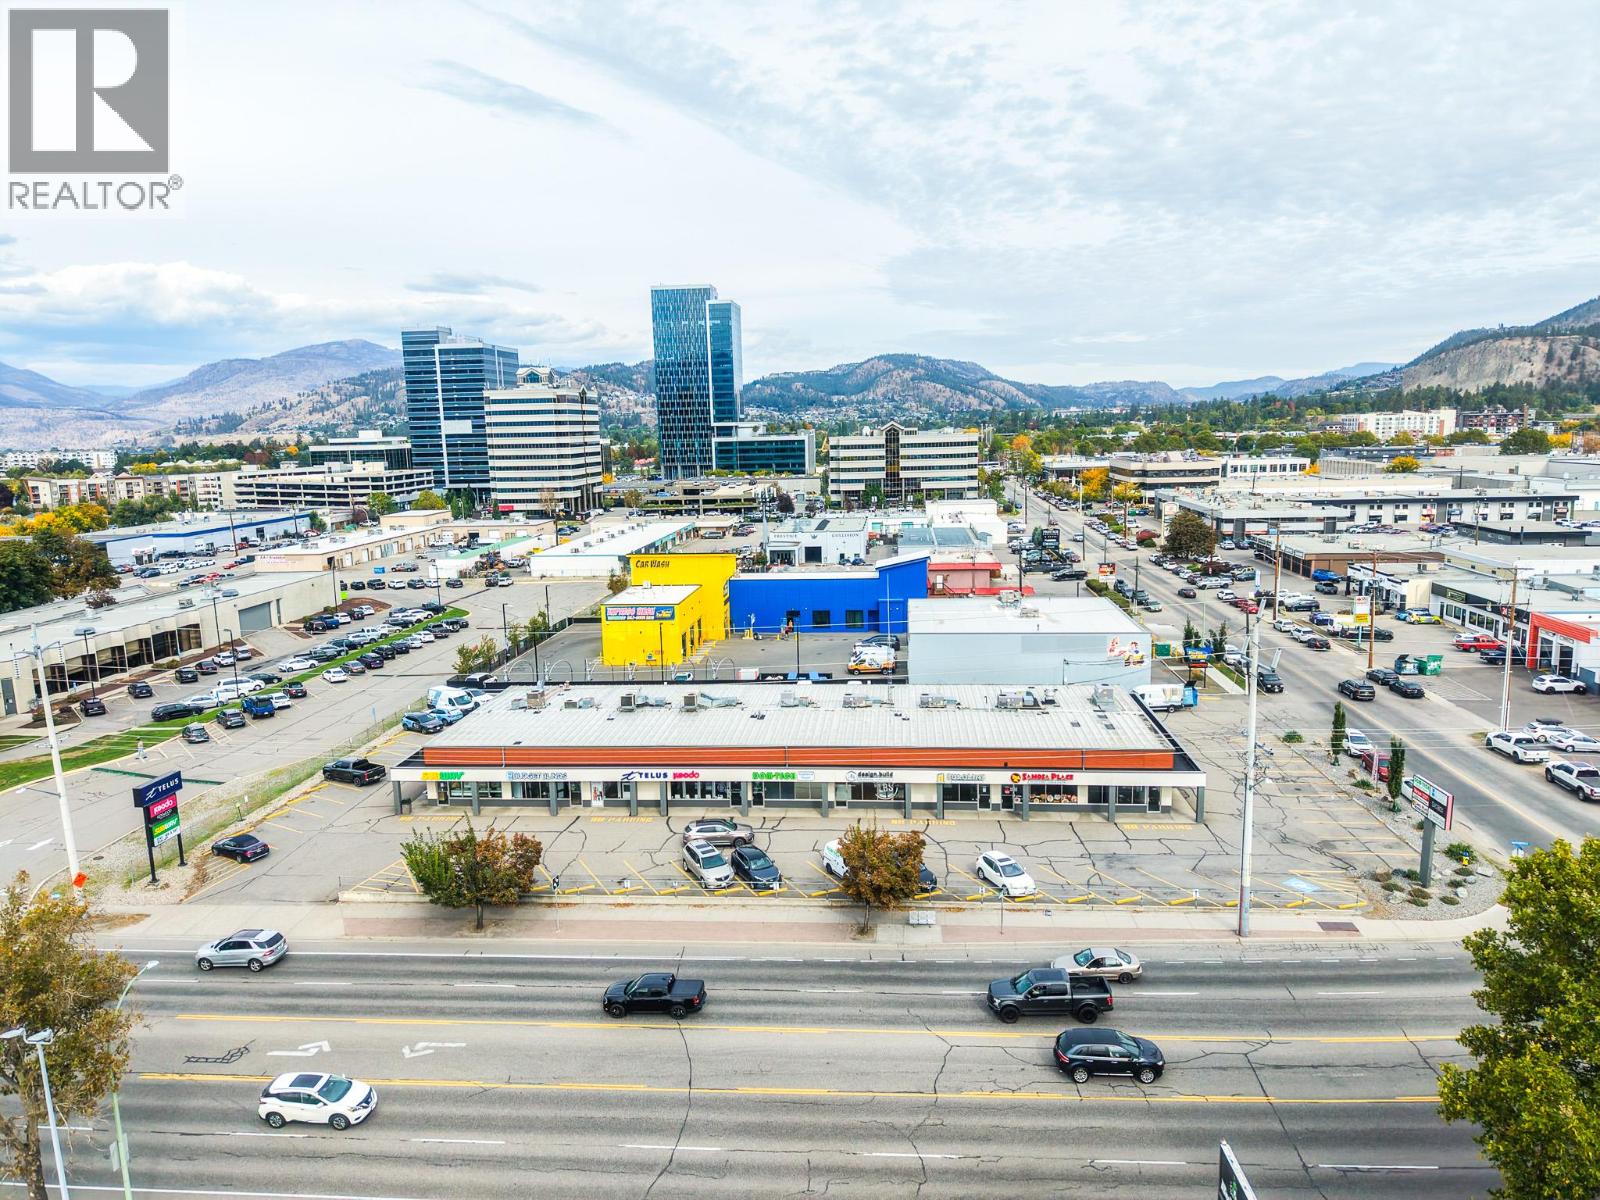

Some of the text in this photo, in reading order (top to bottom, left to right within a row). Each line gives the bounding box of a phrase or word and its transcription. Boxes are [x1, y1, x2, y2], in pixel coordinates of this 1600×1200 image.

[635, 559, 670, 568] CAR WASH
[672, 770, 700, 779] koodo
[1022, 772, 1074, 781] SAMOSA PLACE
[158, 778, 178, 792] TELUS
[153, 799, 173, 815] koodo
